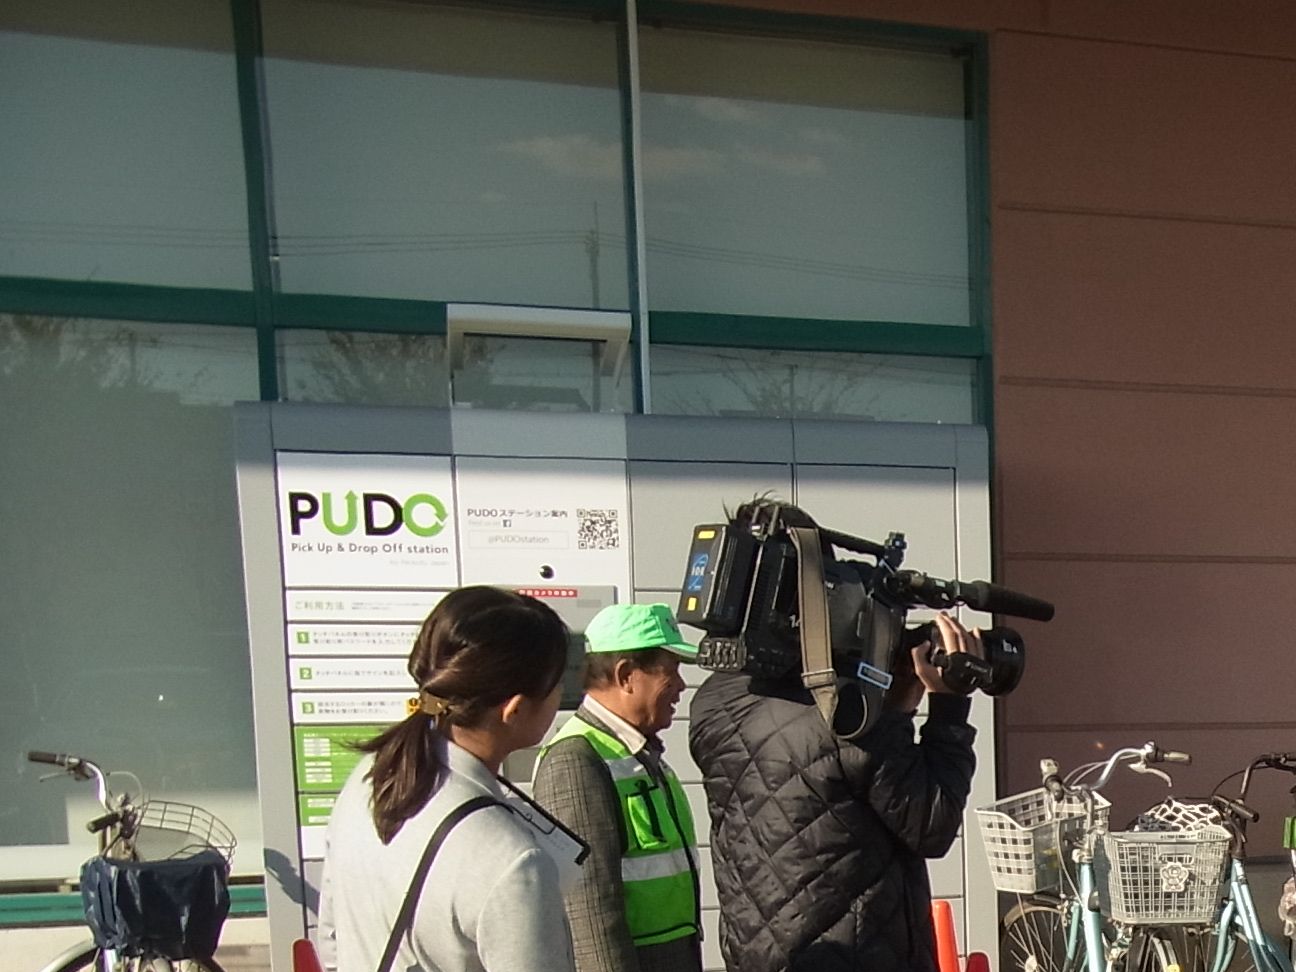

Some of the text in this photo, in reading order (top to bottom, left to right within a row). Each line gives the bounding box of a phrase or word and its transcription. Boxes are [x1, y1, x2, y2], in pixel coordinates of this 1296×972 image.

[288, 489, 449, 538] PUDO
[291, 542, 449, 555] Pick Up & Drop Off station
